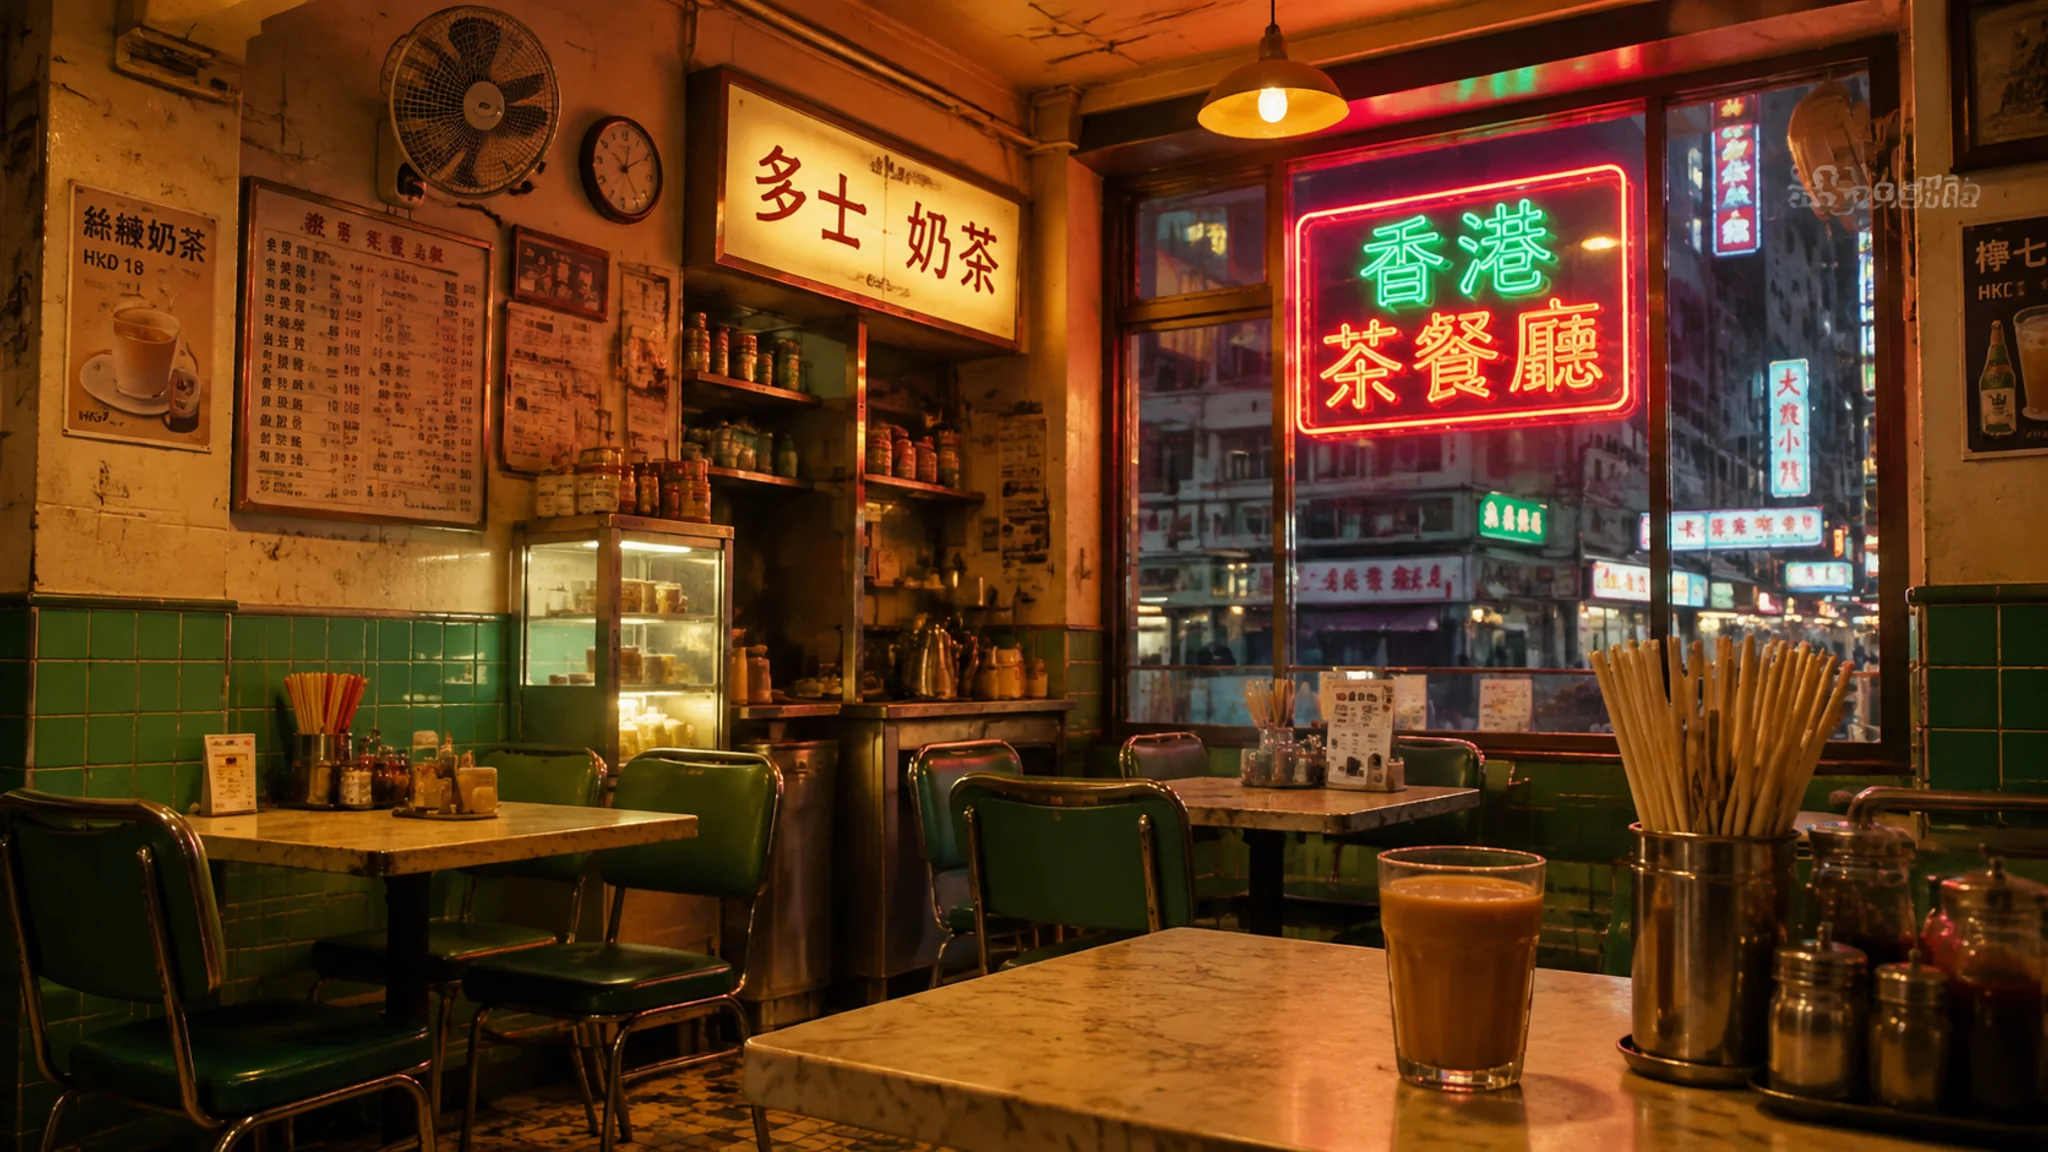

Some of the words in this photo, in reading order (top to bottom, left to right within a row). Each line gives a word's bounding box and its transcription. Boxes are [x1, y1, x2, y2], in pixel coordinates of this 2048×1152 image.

[83, 249, 119, 271] HKD
[124, 257, 145, 276] 18
[755, 145, 867, 250] 多士
[905, 201, 999, 295] 奶茶
[1360, 198, 1550, 309] 香港
[1320, 298, 1603, 409] 茶餐廳
